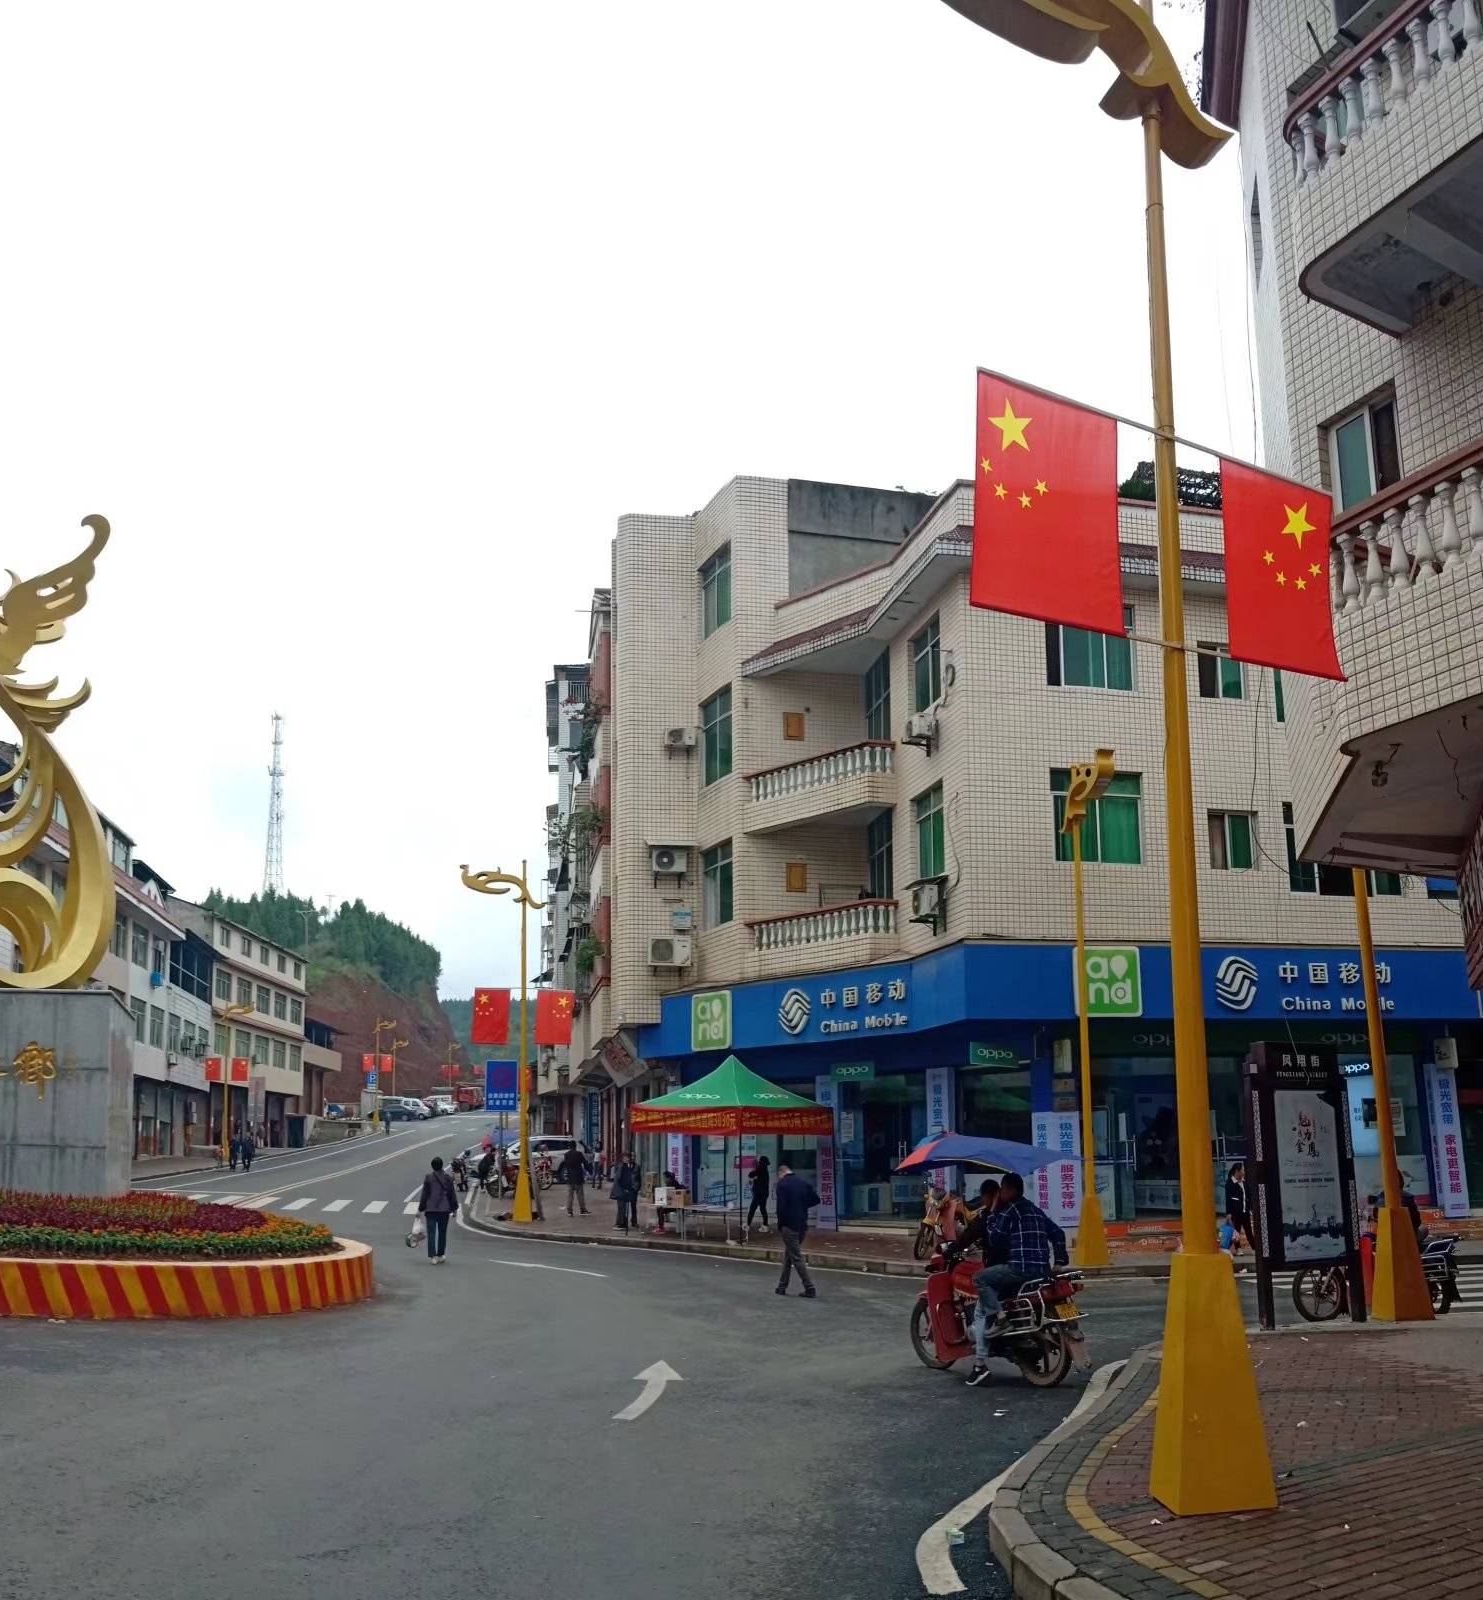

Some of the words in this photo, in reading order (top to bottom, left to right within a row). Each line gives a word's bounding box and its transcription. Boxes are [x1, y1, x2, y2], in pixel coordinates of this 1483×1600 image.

[1278, 961, 1392, 984] 中国移动
[820, 978, 907, 1010] 中国移动
[1282, 996, 1332, 1011] China
[1341, 997, 1396, 1011] Mole
[820, 1019, 858, 1034] China
[865, 1012, 909, 1029] Mobile
[1133, 1034, 1171, 1046] opp
[1321, 1033, 1367, 1046] opp
[1061, 1164, 1076, 1210] 服务不等待
